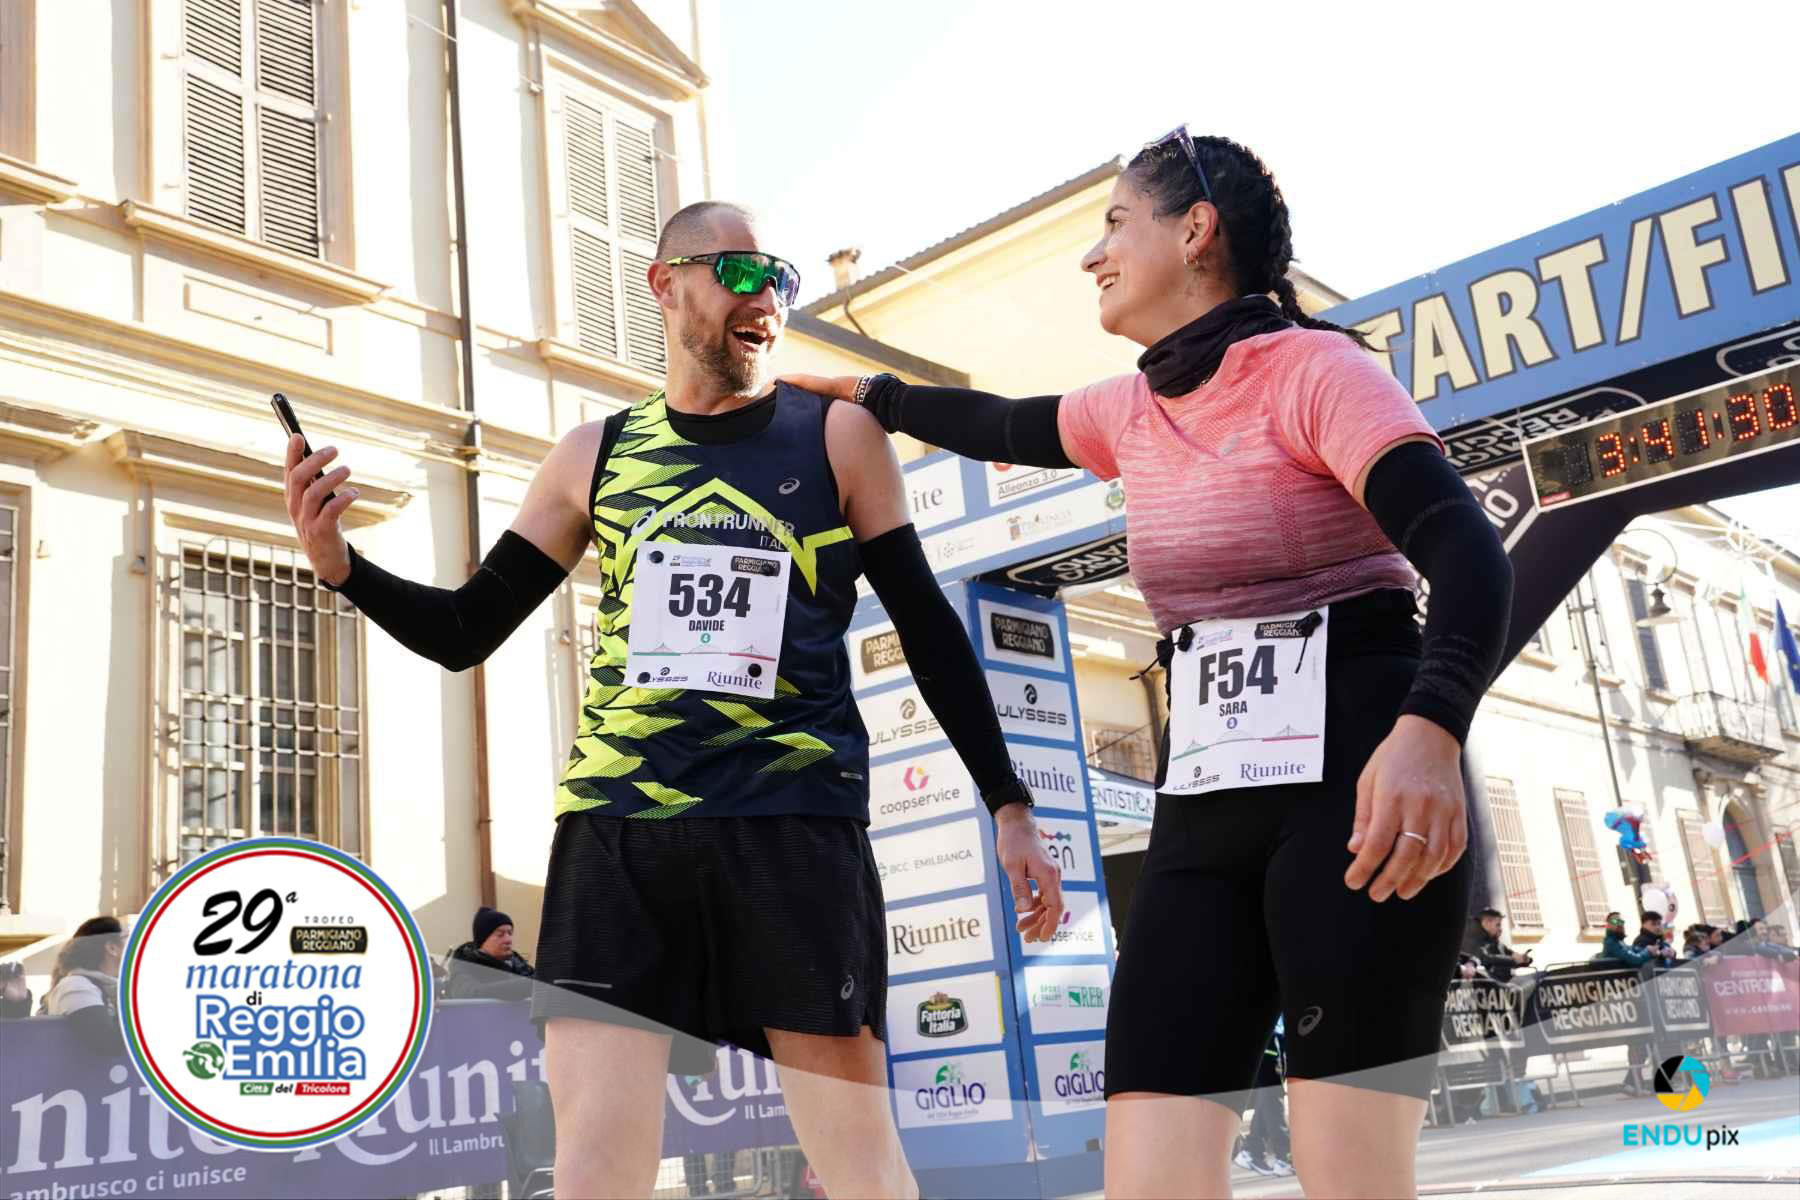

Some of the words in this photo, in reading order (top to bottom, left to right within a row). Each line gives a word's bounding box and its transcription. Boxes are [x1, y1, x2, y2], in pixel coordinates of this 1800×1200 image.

[1348, 164, 1800, 402] TART/FI
[1599, 384, 1798, 478] 3:41:30
[662, 511, 795, 537] FRONTRUNNER
[668, 573, 751, 618] 534
[688, 620, 725, 631] DAVIDE
[706, 671, 763, 690] Riunite
[1198, 645, 1278, 706] F54
[997, 704, 1067, 726] ULYSSES
[1219, 701, 1248, 717] SARA
[1011, 760, 1076, 794] iunite
[1240, 763, 1306, 782] Riunite
[880, 788, 960, 815] coopservice
[891, 917, 980, 955] Riunite
[1538, 976, 1641, 1008] PARMIGIANO
[921, 1007, 961, 1023] Fattoria
[929, 1022, 956, 1034] Italia
[1551, 1001, 1638, 1031] REGGIANO
[916, 1082, 985, 1110] GIGLIO
[146, 1168, 165, 1190] ci
[173, 1164, 247, 1188] unisce
